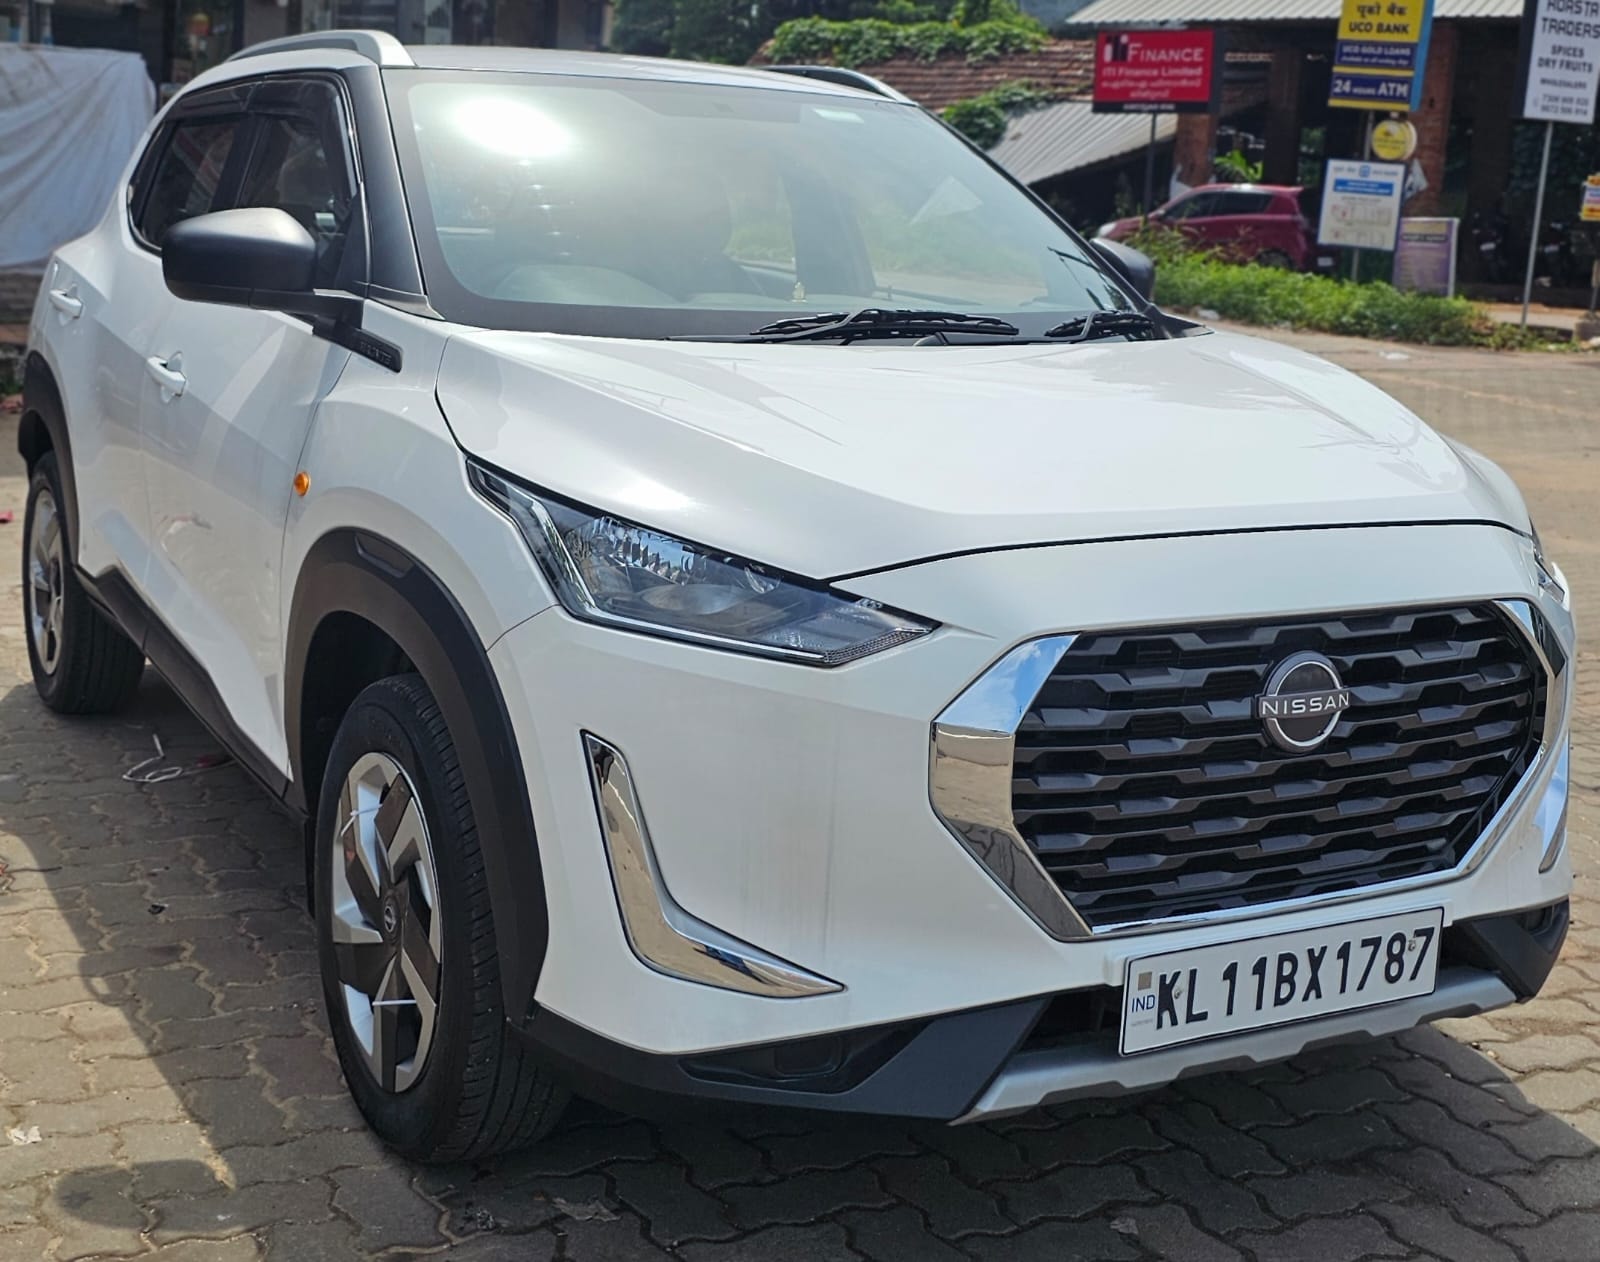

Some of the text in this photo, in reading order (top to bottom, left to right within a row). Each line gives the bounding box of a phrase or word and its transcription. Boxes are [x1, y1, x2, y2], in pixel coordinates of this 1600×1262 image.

[1349, 22, 1409, 34] UCO BANK
[1542, 17, 1600, 39] TRADERS
[1551, 45, 1584, 58] SPICES
[1118, 67, 1159, 77] Finance
[1161, 66, 1203, 77] Limited
[1538, 57, 1593, 73] DRY FRUITS
[1333, 79, 1351, 94] 24
[1378, 82, 1408, 97] ATM
[1262, 692, 1350, 715] NISSAN
[1131, 994, 1156, 1013] IND
